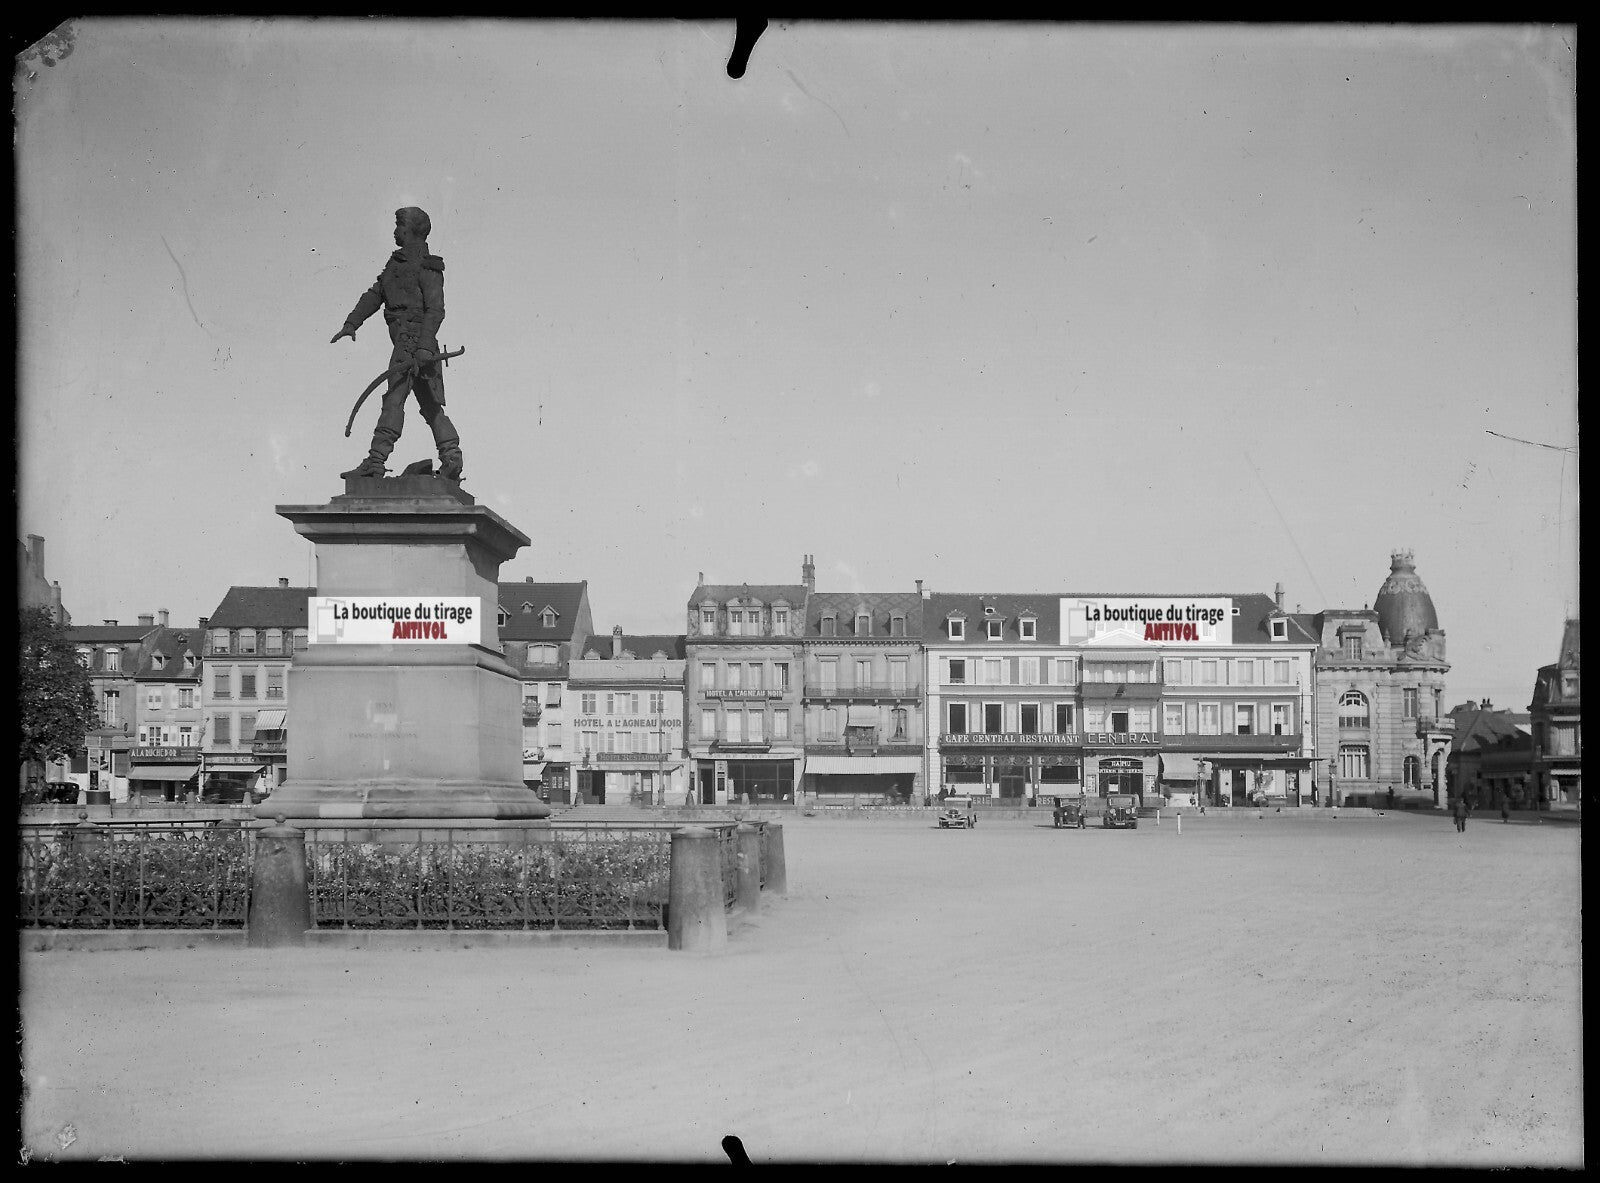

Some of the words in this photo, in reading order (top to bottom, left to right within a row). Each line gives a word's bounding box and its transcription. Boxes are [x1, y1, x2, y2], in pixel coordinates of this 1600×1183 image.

[573, 718, 604, 727] HOTEL
[607, 719, 613, 727] A
[660, 719, 682, 728] NOIR
[945, 734, 969, 743] CAFE
[972, 734, 1016, 743] CENTRAL
[1019, 734, 1080, 743] RESTAURANT
[1088, 733, 1159, 743] CENTRAL
